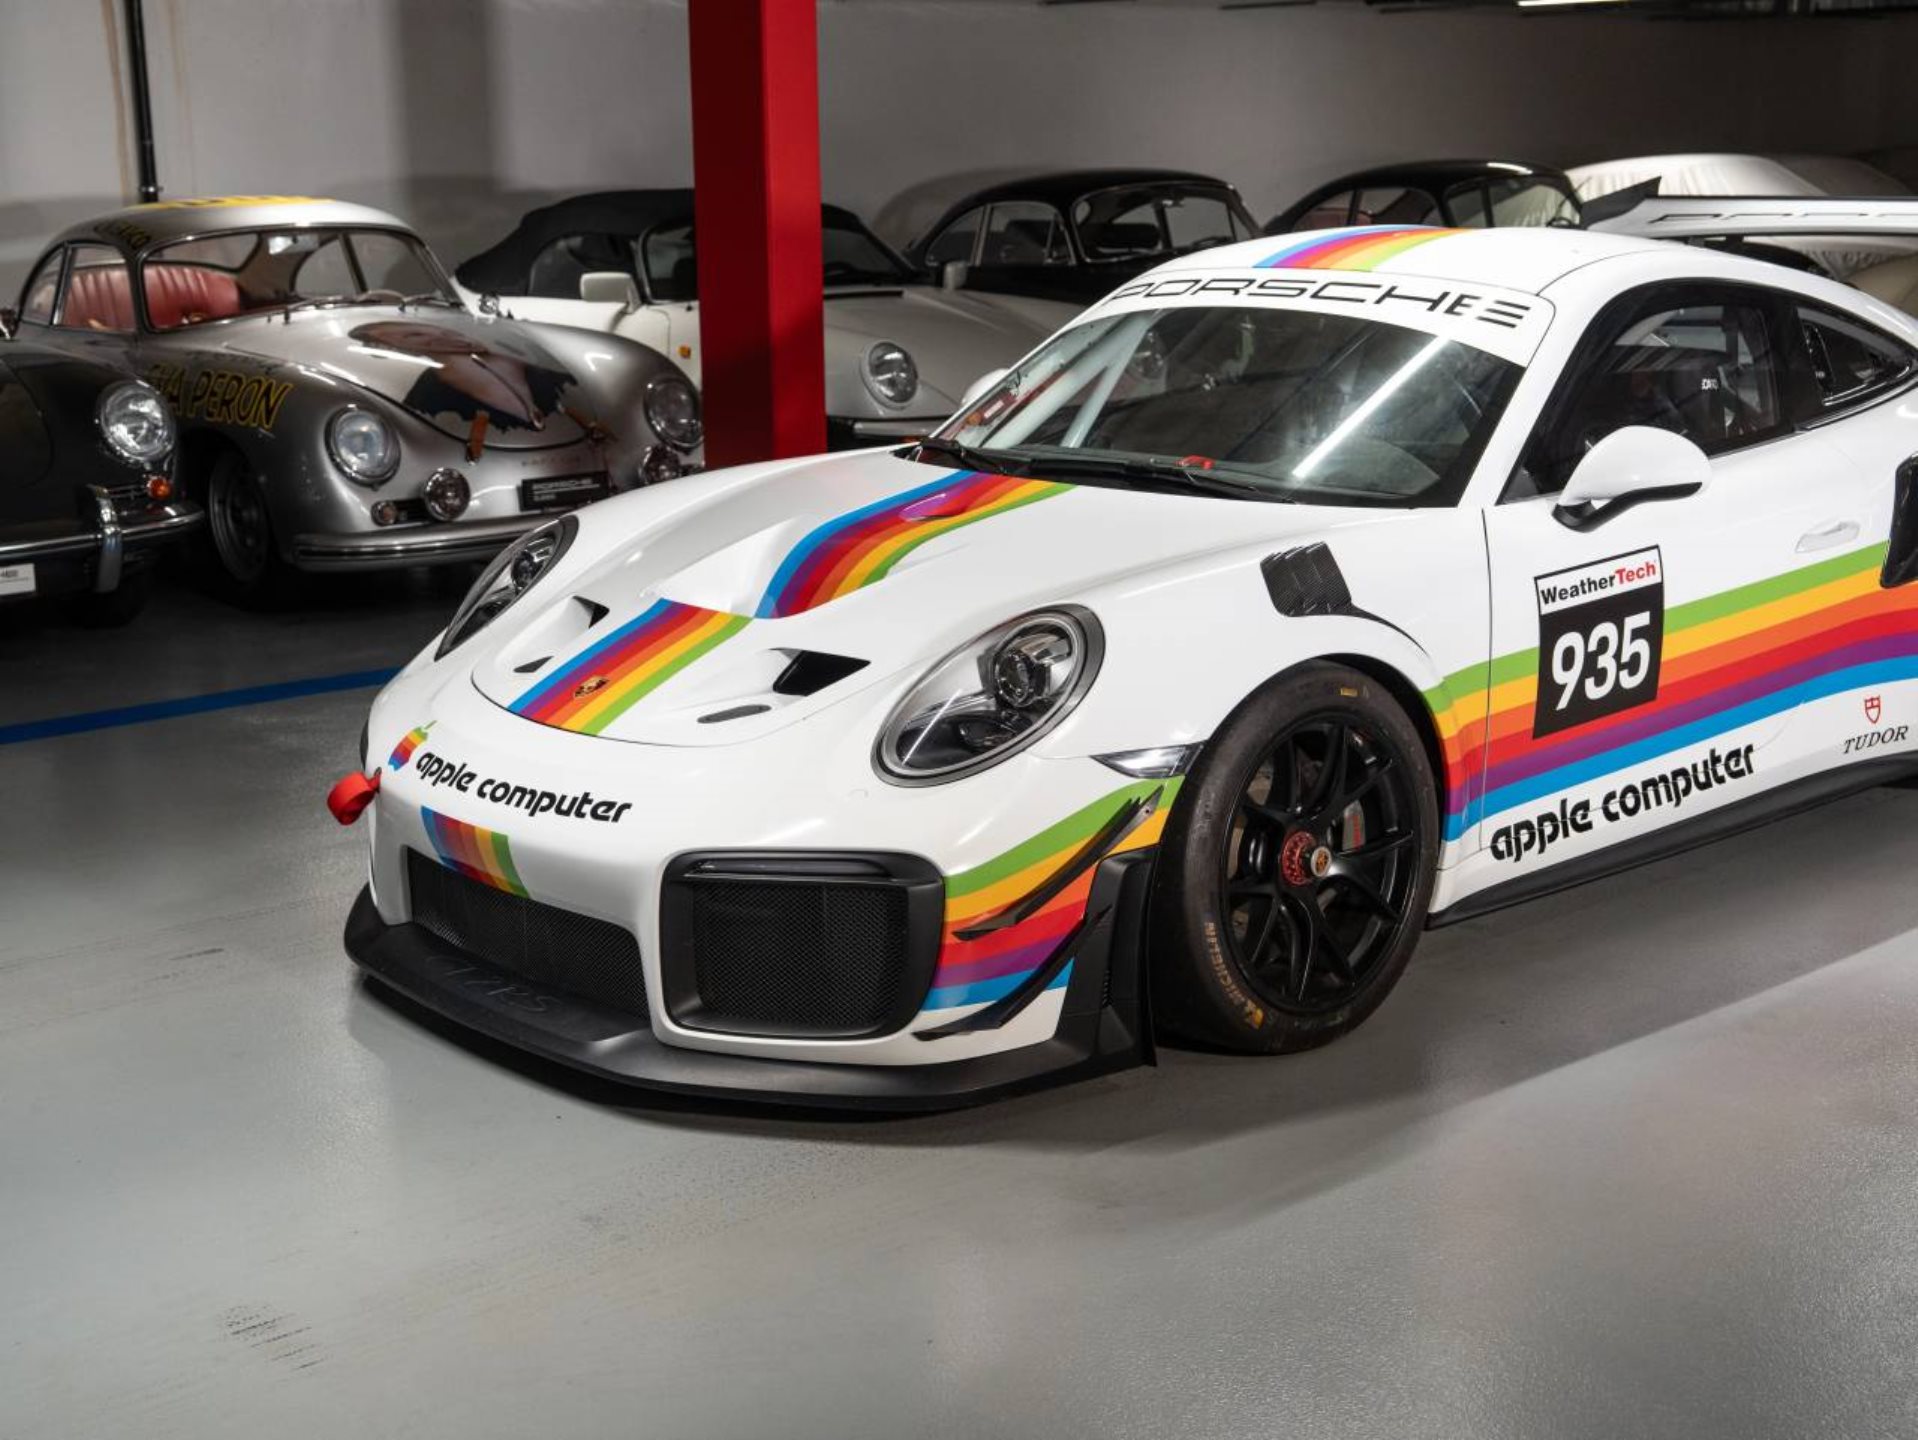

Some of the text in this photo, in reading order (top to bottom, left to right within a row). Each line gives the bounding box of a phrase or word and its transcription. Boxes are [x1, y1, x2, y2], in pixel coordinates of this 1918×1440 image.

[1110, 278, 1530, 329] PORSCHE
[186, 368, 295, 431] PERON
[1540, 562, 1657, 605] WeatherTech
[1552, 611, 1650, 711] 935
[1843, 725, 1909, 755] TUDOR
[416, 752, 633, 823] apple computer
[1490, 744, 1754, 862] apple computer
